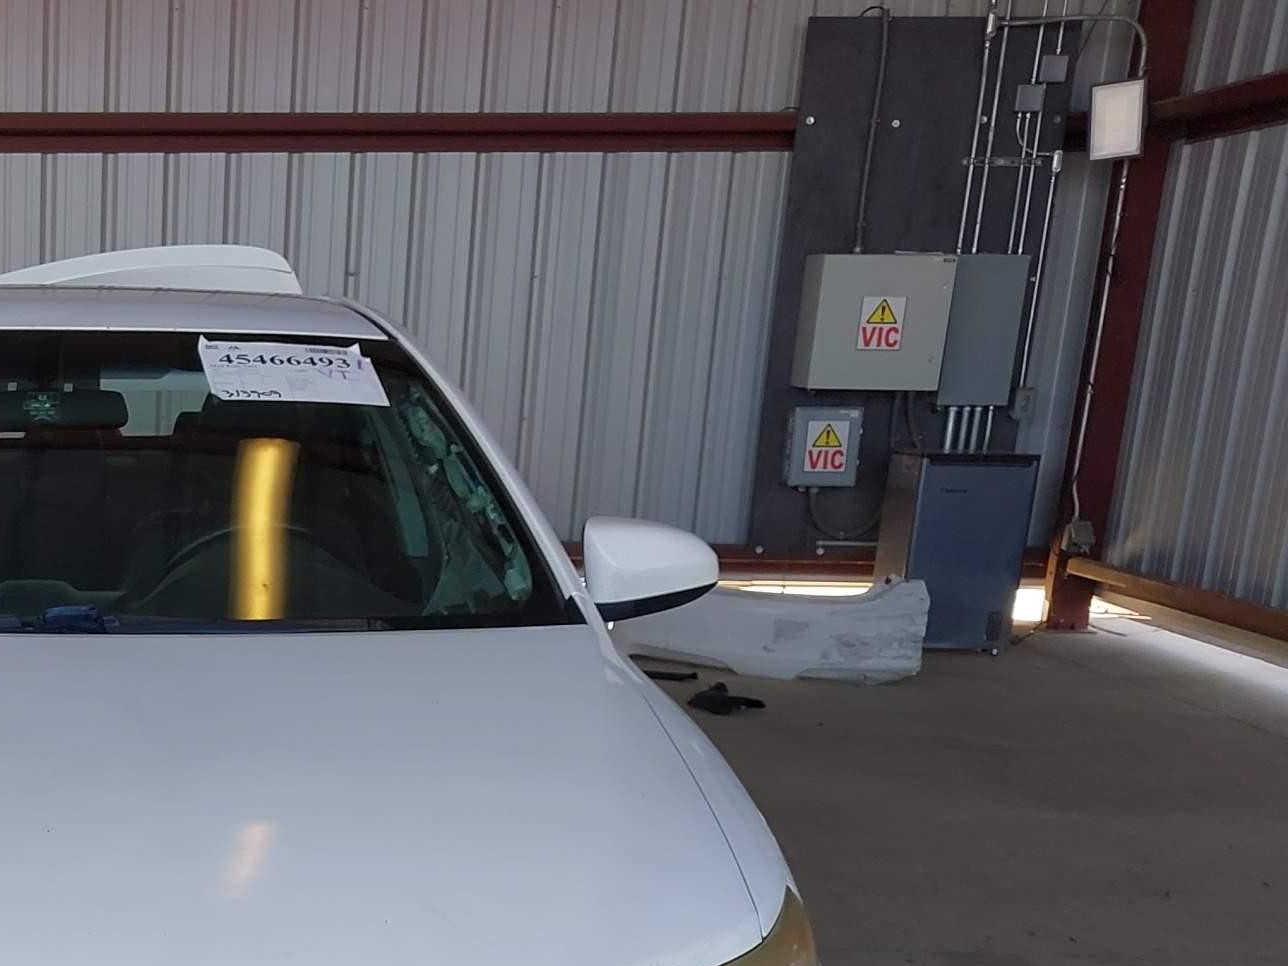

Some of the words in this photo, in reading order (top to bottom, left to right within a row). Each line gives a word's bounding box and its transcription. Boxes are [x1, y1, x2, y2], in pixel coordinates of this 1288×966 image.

[860, 325, 900, 348] VIC
[218, 353, 351, 369] 45466493
[807, 448, 844, 470] VIC
